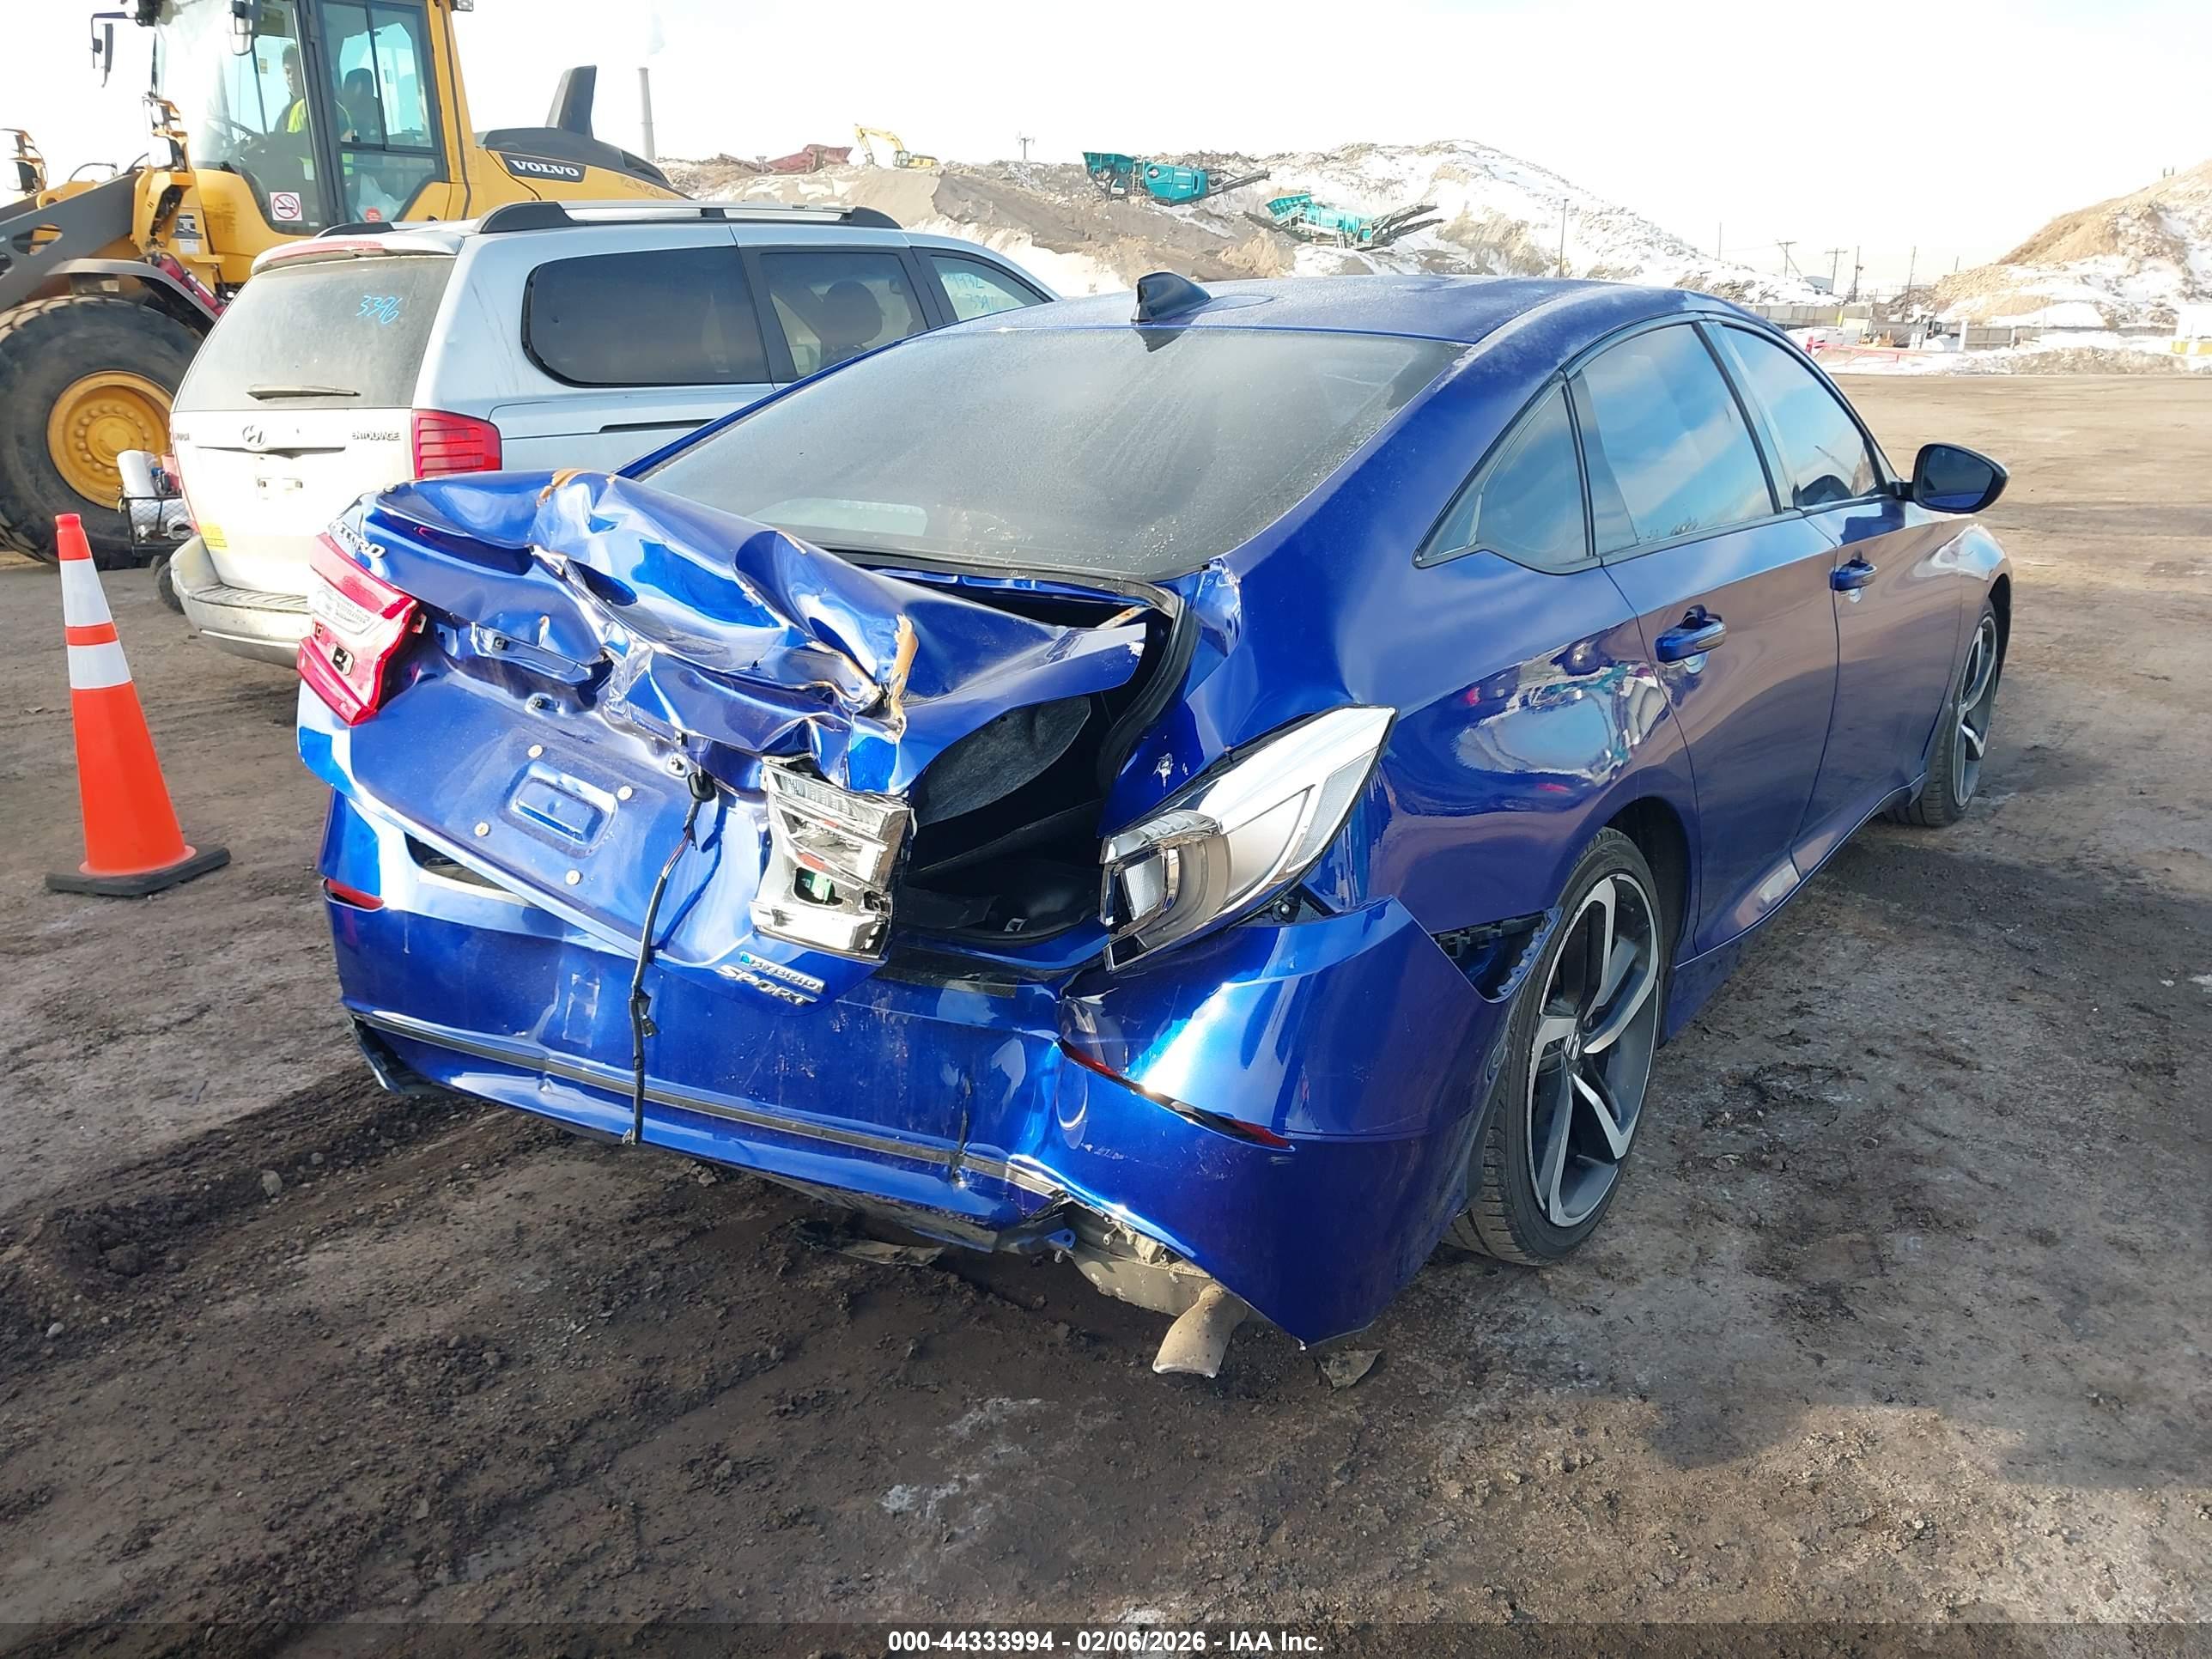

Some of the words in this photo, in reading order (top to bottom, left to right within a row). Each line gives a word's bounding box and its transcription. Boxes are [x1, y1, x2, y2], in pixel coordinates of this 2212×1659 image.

[509, 160, 580, 177] VOLVO
[356, 295, 403, 324] 3396
[716, 964, 818, 1006] SPORT
[745, 955, 824, 994] HYBRID
